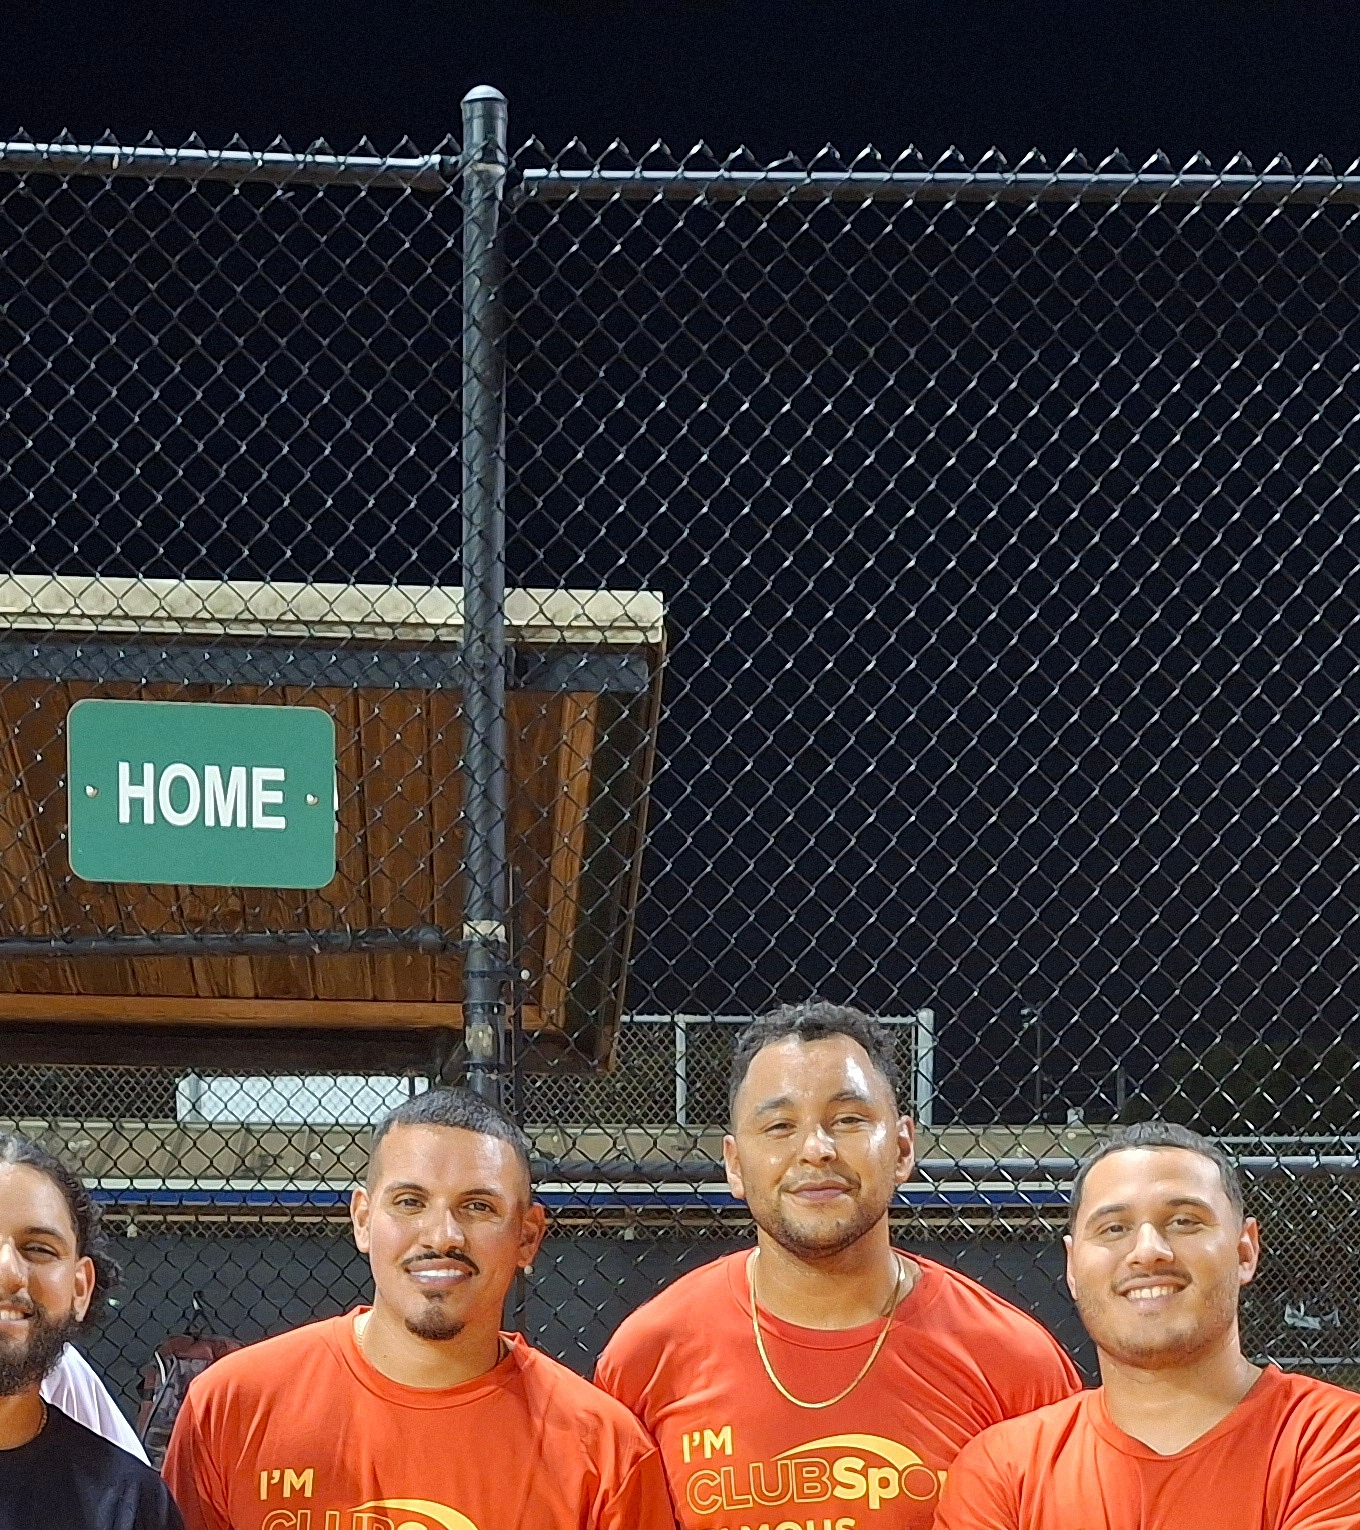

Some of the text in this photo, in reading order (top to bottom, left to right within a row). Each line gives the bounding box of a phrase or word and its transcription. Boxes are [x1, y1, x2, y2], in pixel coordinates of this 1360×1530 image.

[118, 761, 286, 829] HOME
[682, 1425, 733, 1463] I'M
[259, 1467, 314, 1500] I'M
[686, 1456, 948, 1515] CLUBSpo
